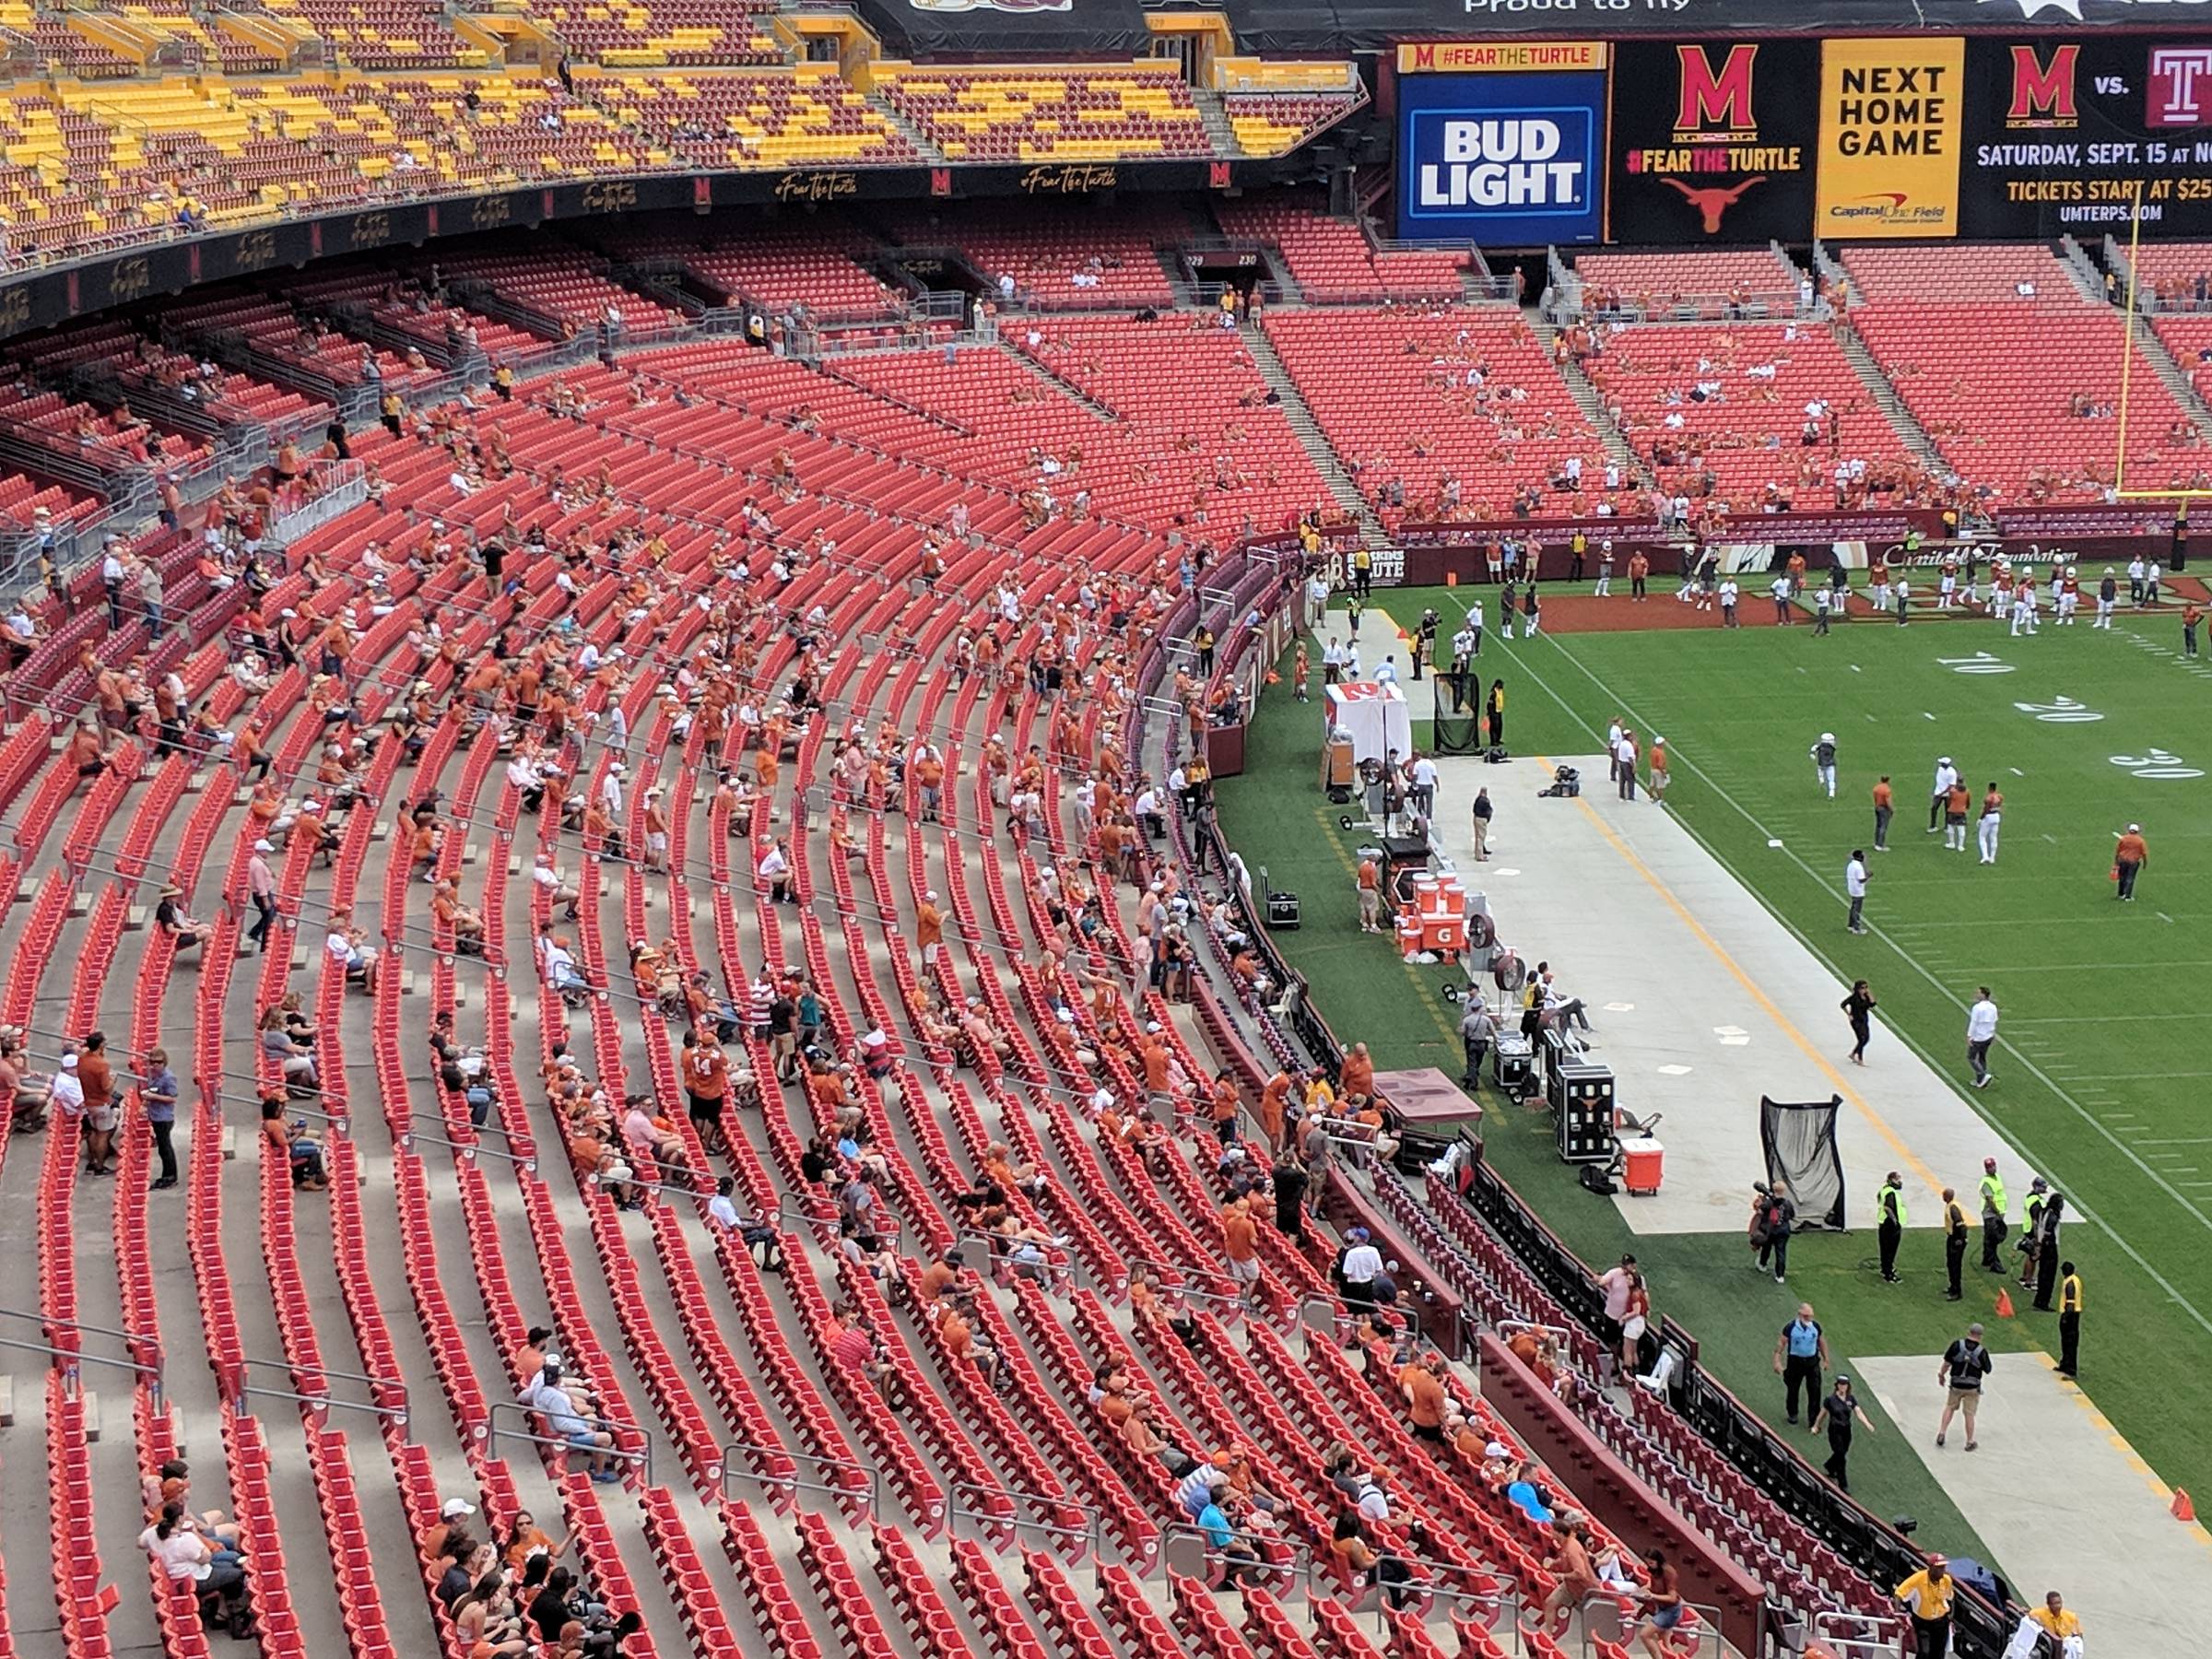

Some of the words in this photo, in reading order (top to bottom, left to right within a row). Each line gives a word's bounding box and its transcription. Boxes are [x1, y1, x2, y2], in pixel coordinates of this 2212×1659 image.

[1443, 47, 1590, 65] #FEARTHETURTLE
[1676, 44, 1759, 130] M
[1841, 66, 1946, 93] NEXT
[2006, 45, 2080, 118] M
[1840, 99, 1945, 125] HOME
[1443, 121, 1560, 162] BUD
[1838, 130, 1943, 156] GAME
[1626, 147, 1801, 174] #FEARTHETURTLE
[1977, 144, 2081, 167] SATURDAY,
[2087, 144, 2140, 164] SEPT.
[2146, 143, 2167, 163] 15
[2171, 148, 2190, 163] AT
[1420, 162, 1582, 206] LIGHT
[2006, 181, 2083, 201] TICKETS
[2149, 180, 2173, 198] AT
[2177, 178, 2212, 200] $25
[1347, 561, 1405, 580] SUTE
[1438, 927, 1452, 942] G
